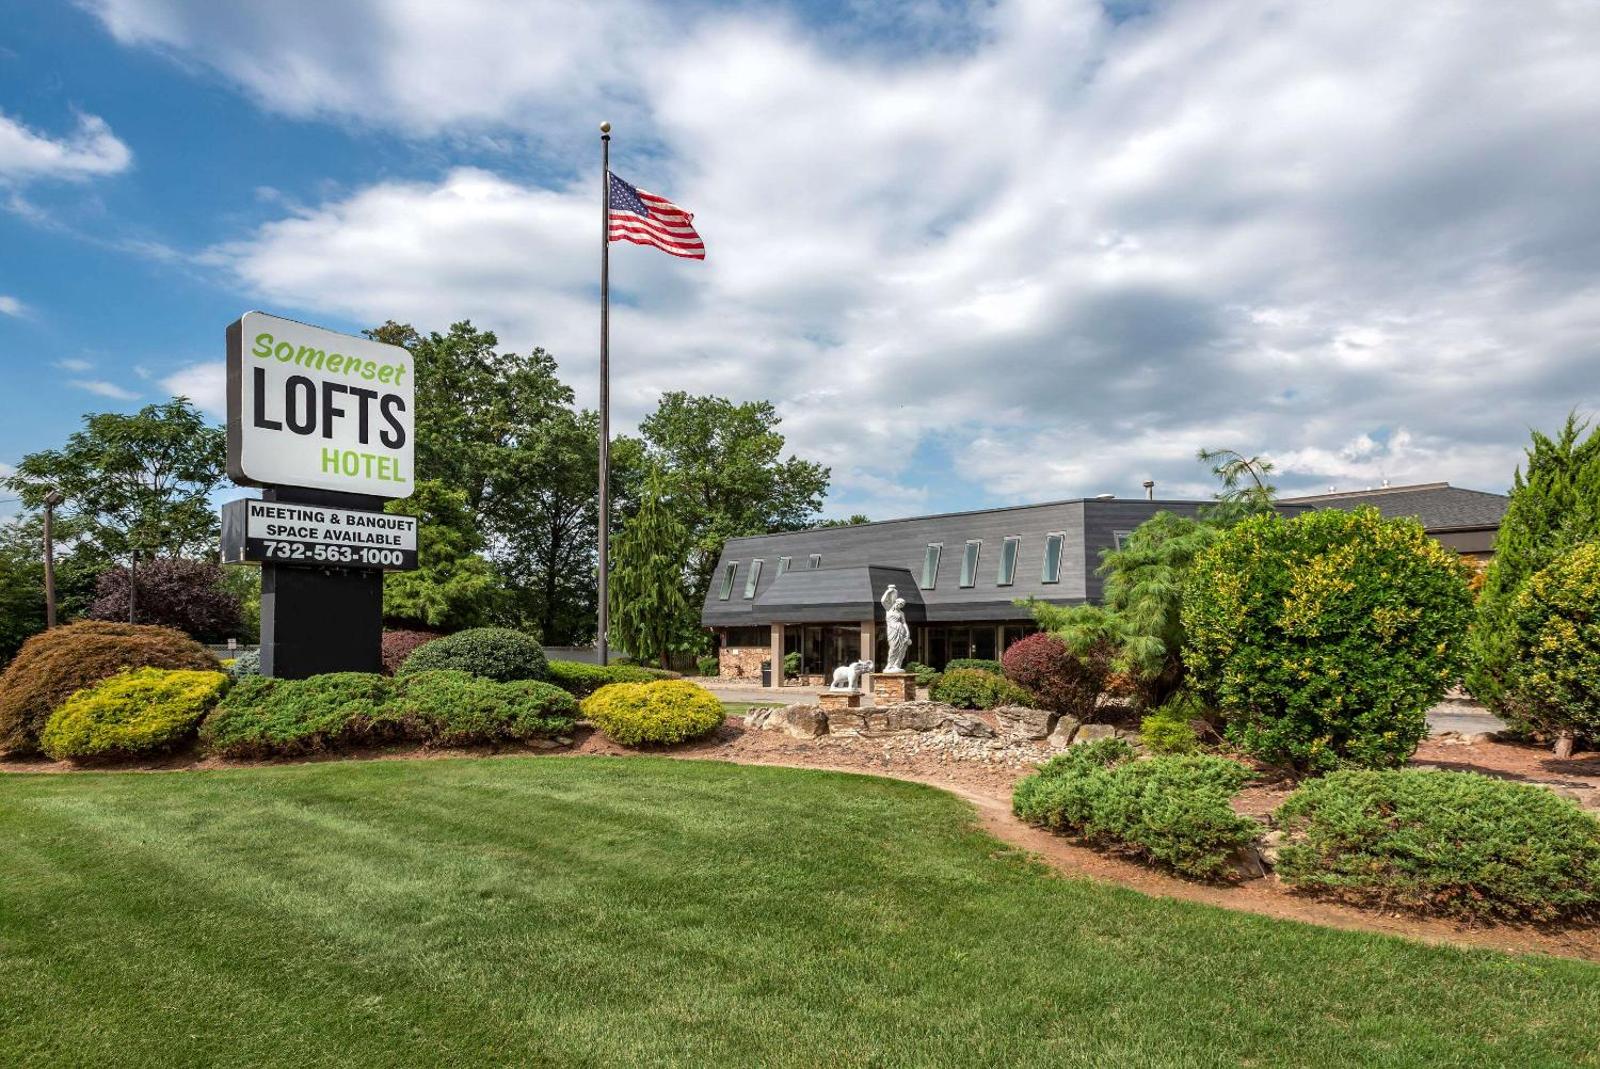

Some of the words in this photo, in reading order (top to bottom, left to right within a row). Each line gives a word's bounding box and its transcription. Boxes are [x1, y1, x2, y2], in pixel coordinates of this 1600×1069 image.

[252, 333, 406, 386] Somerset
[254, 367, 406, 449] LOFTS
[321, 448, 406, 482] HOTEL
[251, 505, 325, 524] MEETING
[330, 513, 341, 525] &
[346, 517, 414, 532] BANQUET
[267, 524, 319, 539] SPACE
[323, 529, 402, 546] AVAILABLE
[263, 541, 403, 565] 732-563-1000
